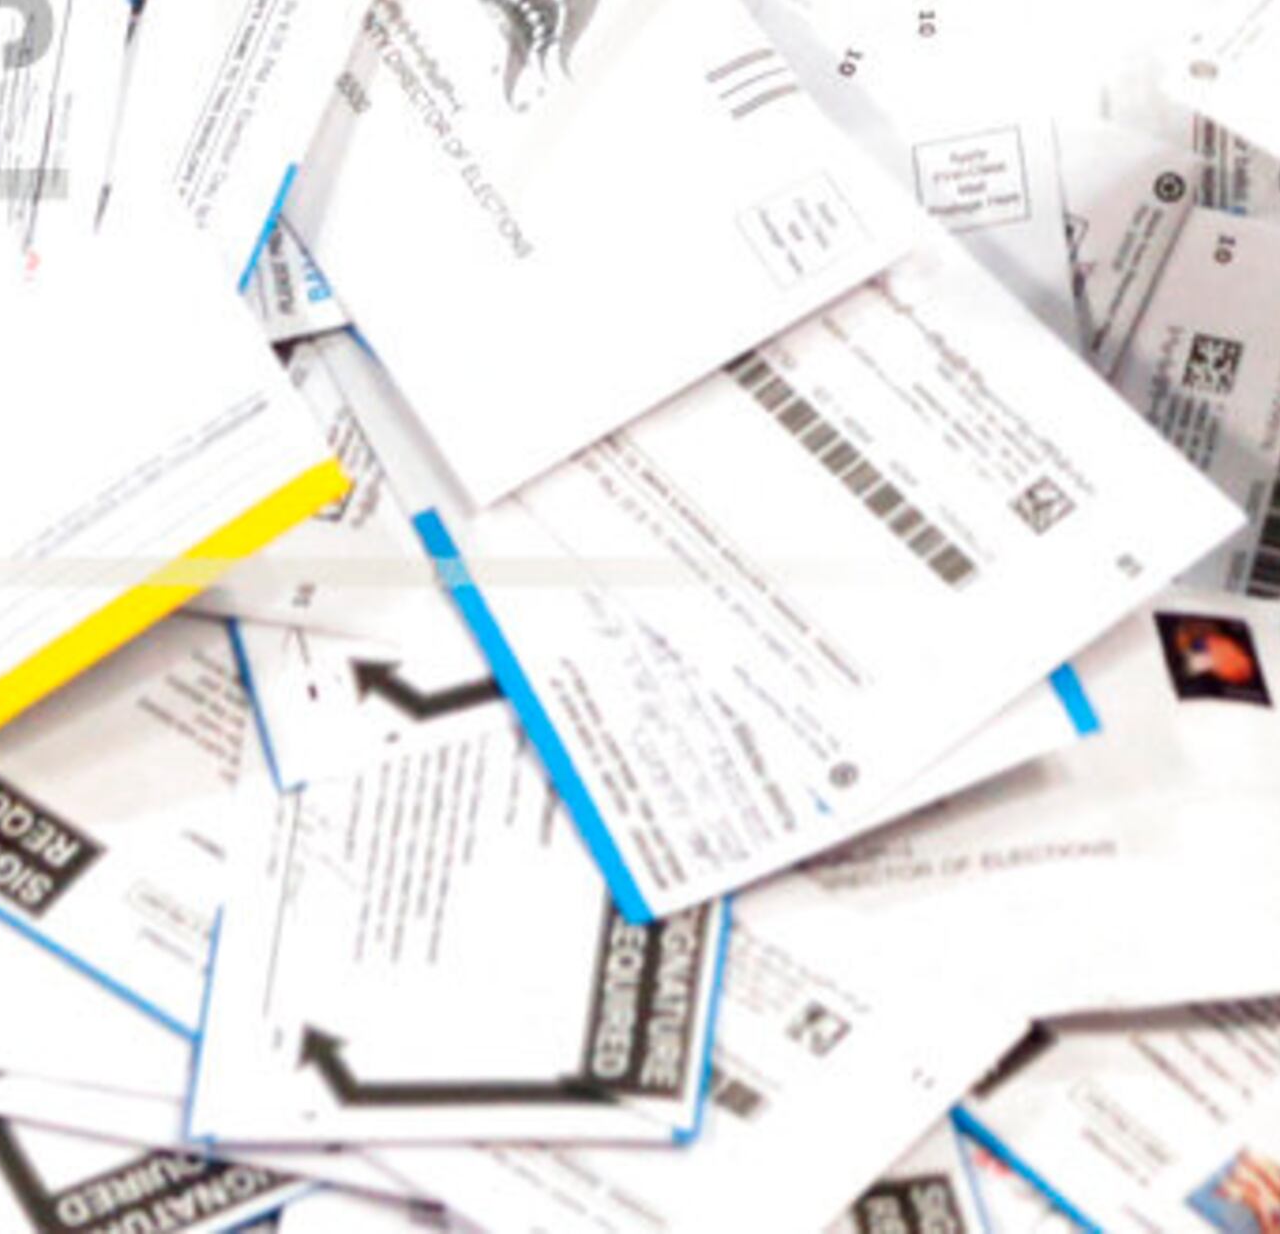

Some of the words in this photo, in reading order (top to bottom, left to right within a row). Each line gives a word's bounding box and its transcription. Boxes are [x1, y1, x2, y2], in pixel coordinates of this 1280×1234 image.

[917, 9, 935, 38] 10
[836, 46, 864, 80] 10
[381, 47, 454, 141] DIRECTOR
[440, 135, 470, 166] OF
[458, 160, 536, 263] ELECTIONS
[948, 145, 987, 166] Apply
[1211, 231, 1237, 265] 10
[981, 839, 1115, 871] ELECTIONS
